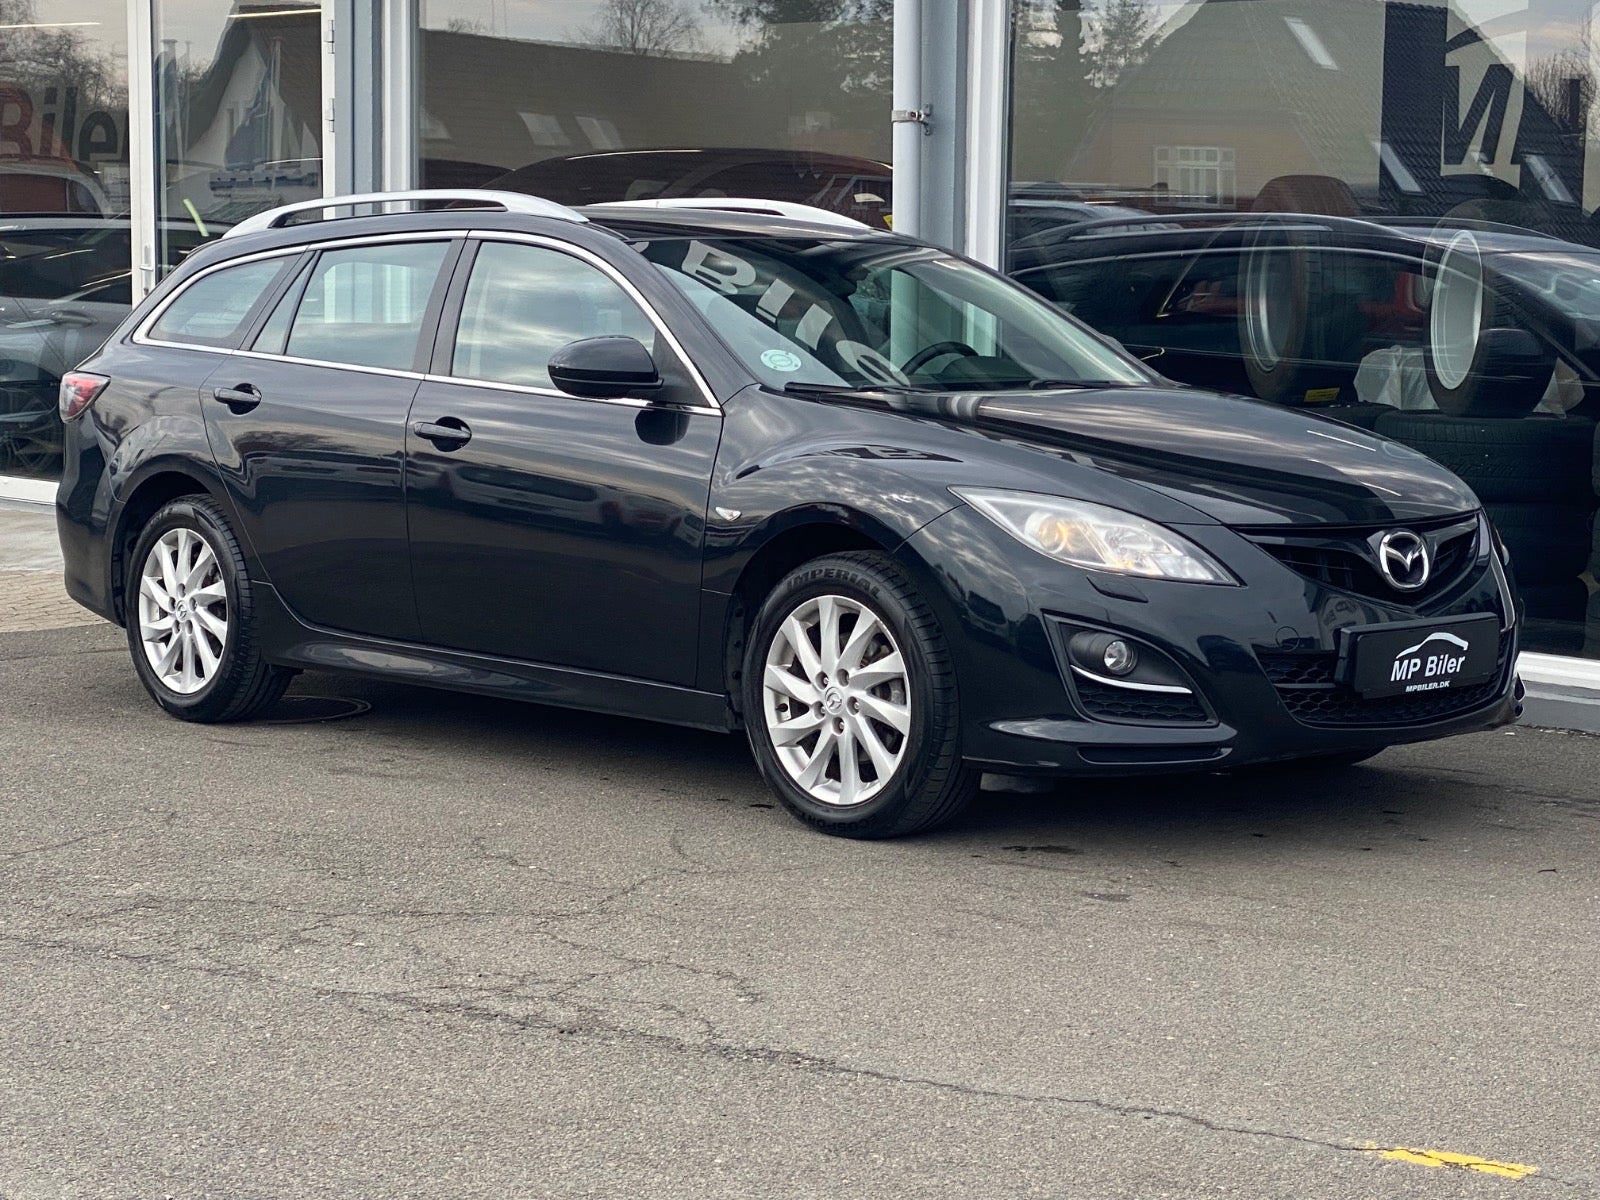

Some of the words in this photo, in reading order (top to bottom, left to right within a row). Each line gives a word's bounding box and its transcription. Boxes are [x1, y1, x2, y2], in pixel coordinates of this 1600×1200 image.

[787, 567, 881, 599] IMPERIAL
[1390, 658, 1421, 682] MP
[1425, 654, 1466, 677] Biler
[1405, 680, 1451, 693] MPBILER.DK
